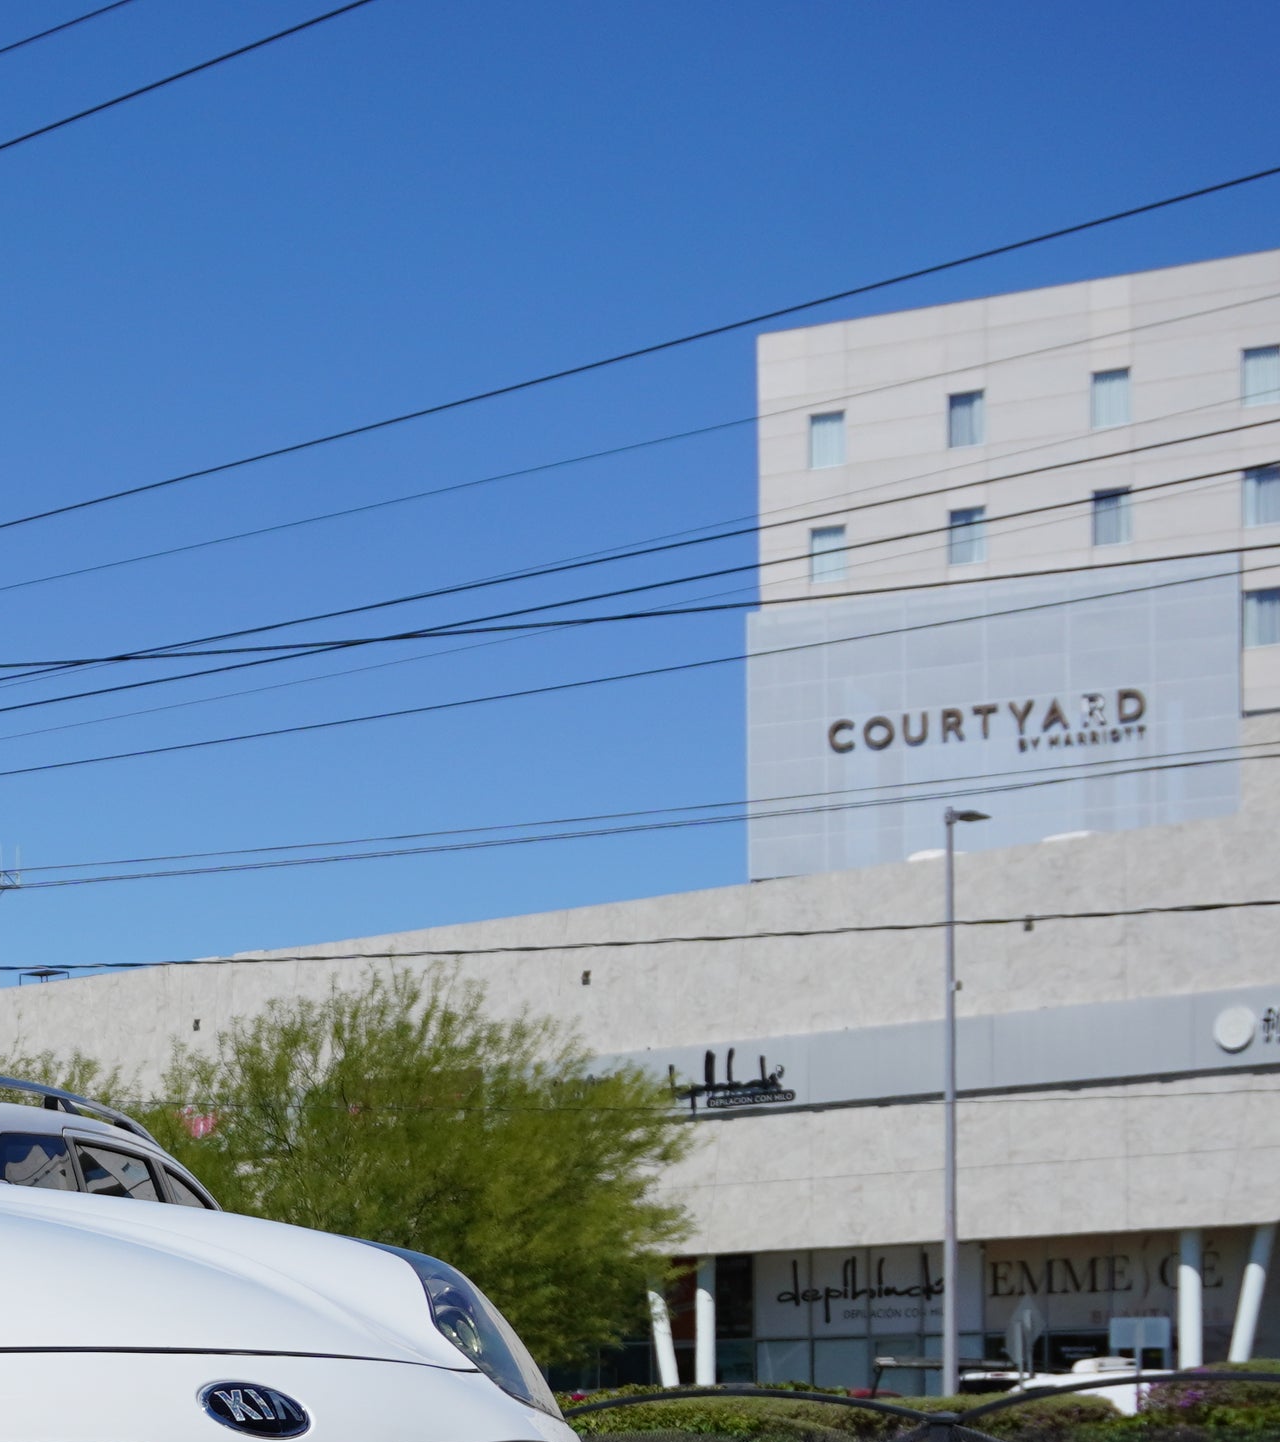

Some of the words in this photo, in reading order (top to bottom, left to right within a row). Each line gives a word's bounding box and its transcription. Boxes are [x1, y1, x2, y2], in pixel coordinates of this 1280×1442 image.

[827, 687, 1148, 754] COURTYARD
[1018, 736, 1041, 753] BY
[1048, 725, 1147, 749] MARRIOTT
[214, 1388, 304, 1422] KIA
